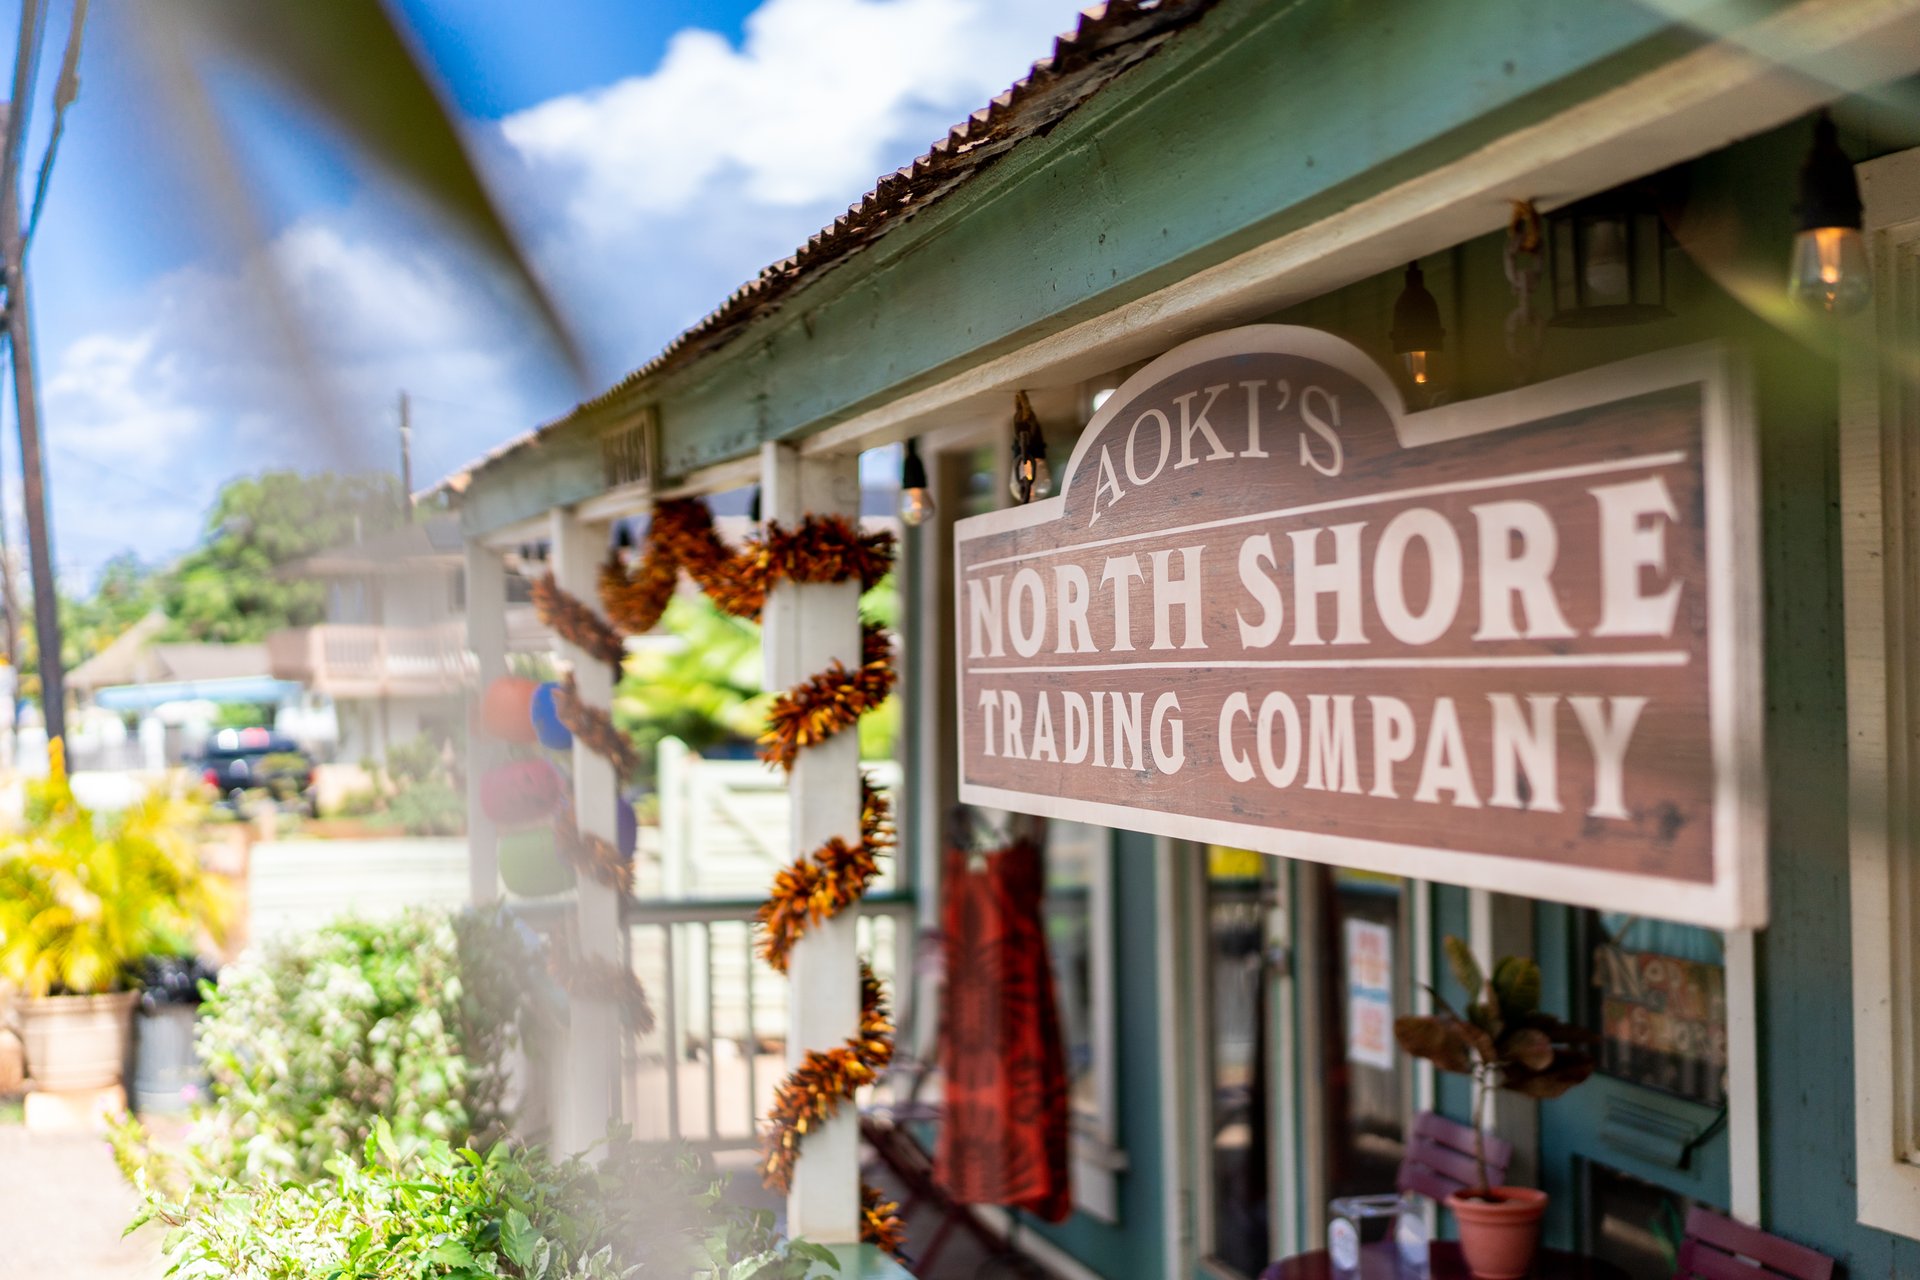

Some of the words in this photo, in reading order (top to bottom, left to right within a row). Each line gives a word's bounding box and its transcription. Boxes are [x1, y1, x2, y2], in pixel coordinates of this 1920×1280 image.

[1088, 379, 1344, 528] AOKI'S
[966, 545, 1209, 659] NORTH
[1235, 475, 1684, 650] SHORE
[979, 689, 1185, 775] TRADING
[1218, 690, 1649, 820] COMPANY
